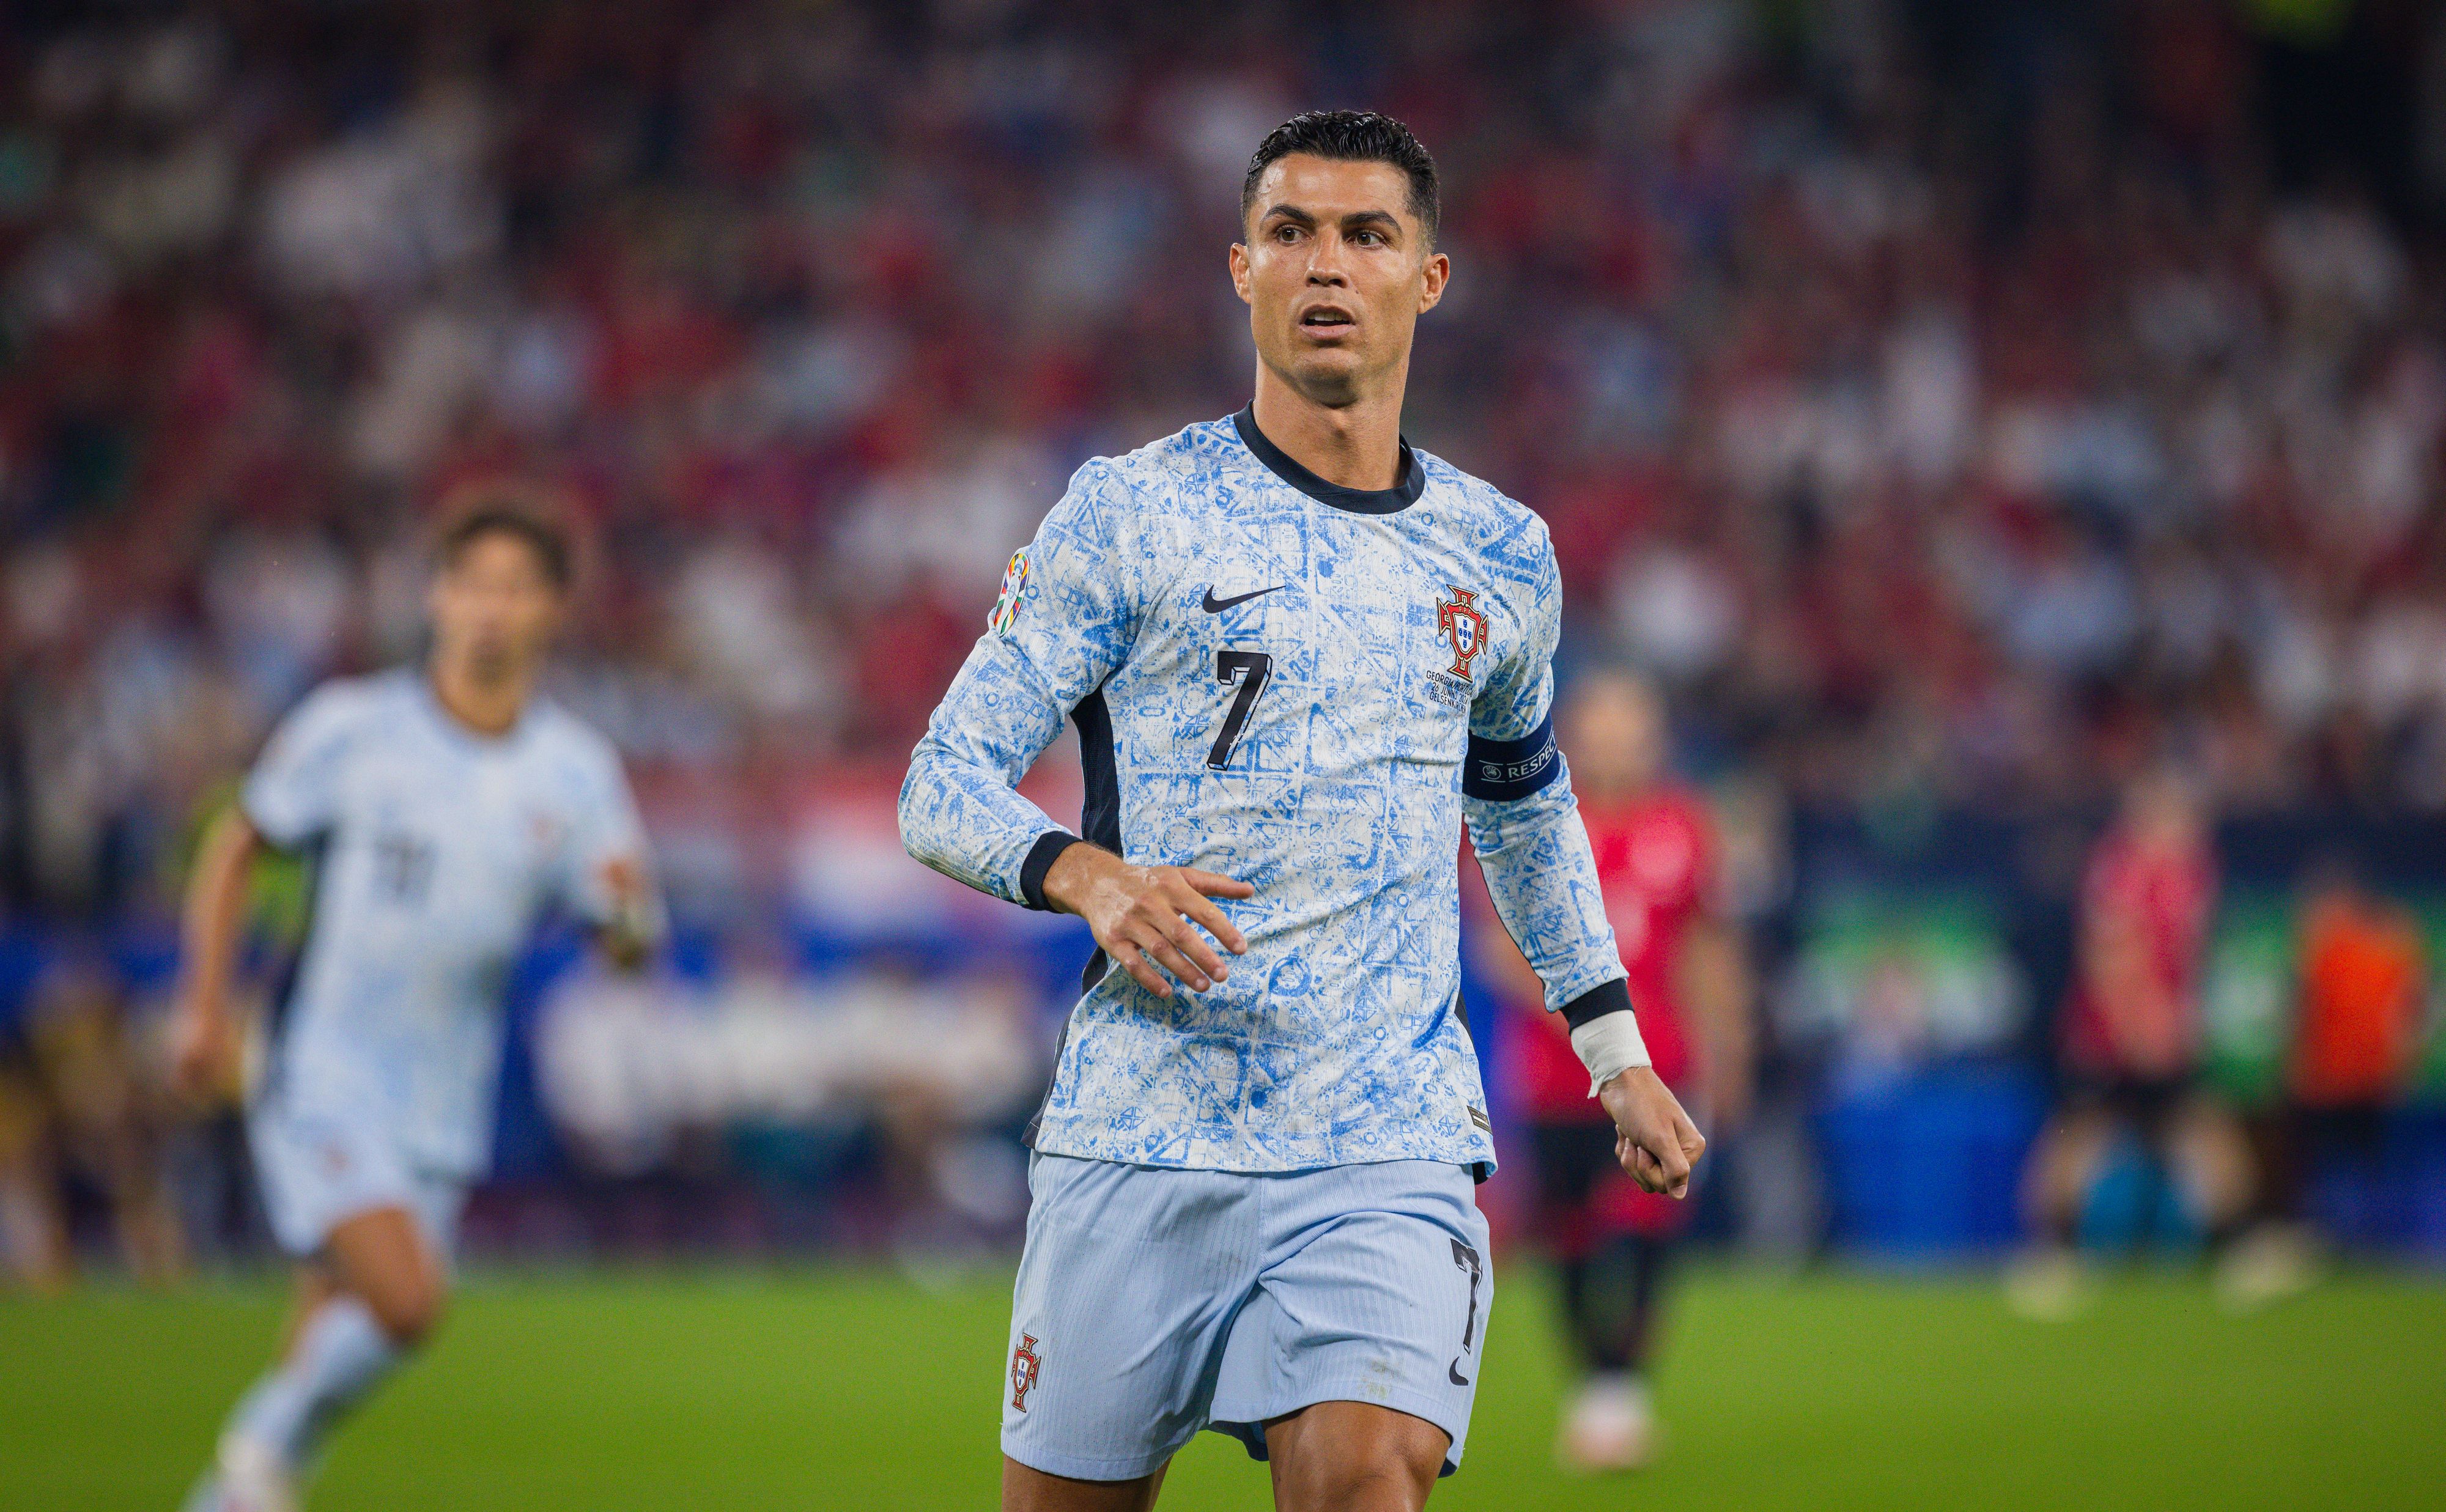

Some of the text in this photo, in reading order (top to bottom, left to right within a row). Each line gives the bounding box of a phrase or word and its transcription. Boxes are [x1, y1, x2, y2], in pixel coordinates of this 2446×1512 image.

[1206, 651, 1273, 771] 7
[1431, 682, 1439, 692] 26
[1441, 685, 1458, 700] JUNHO
[1450, 1237, 1483, 1356] 7
